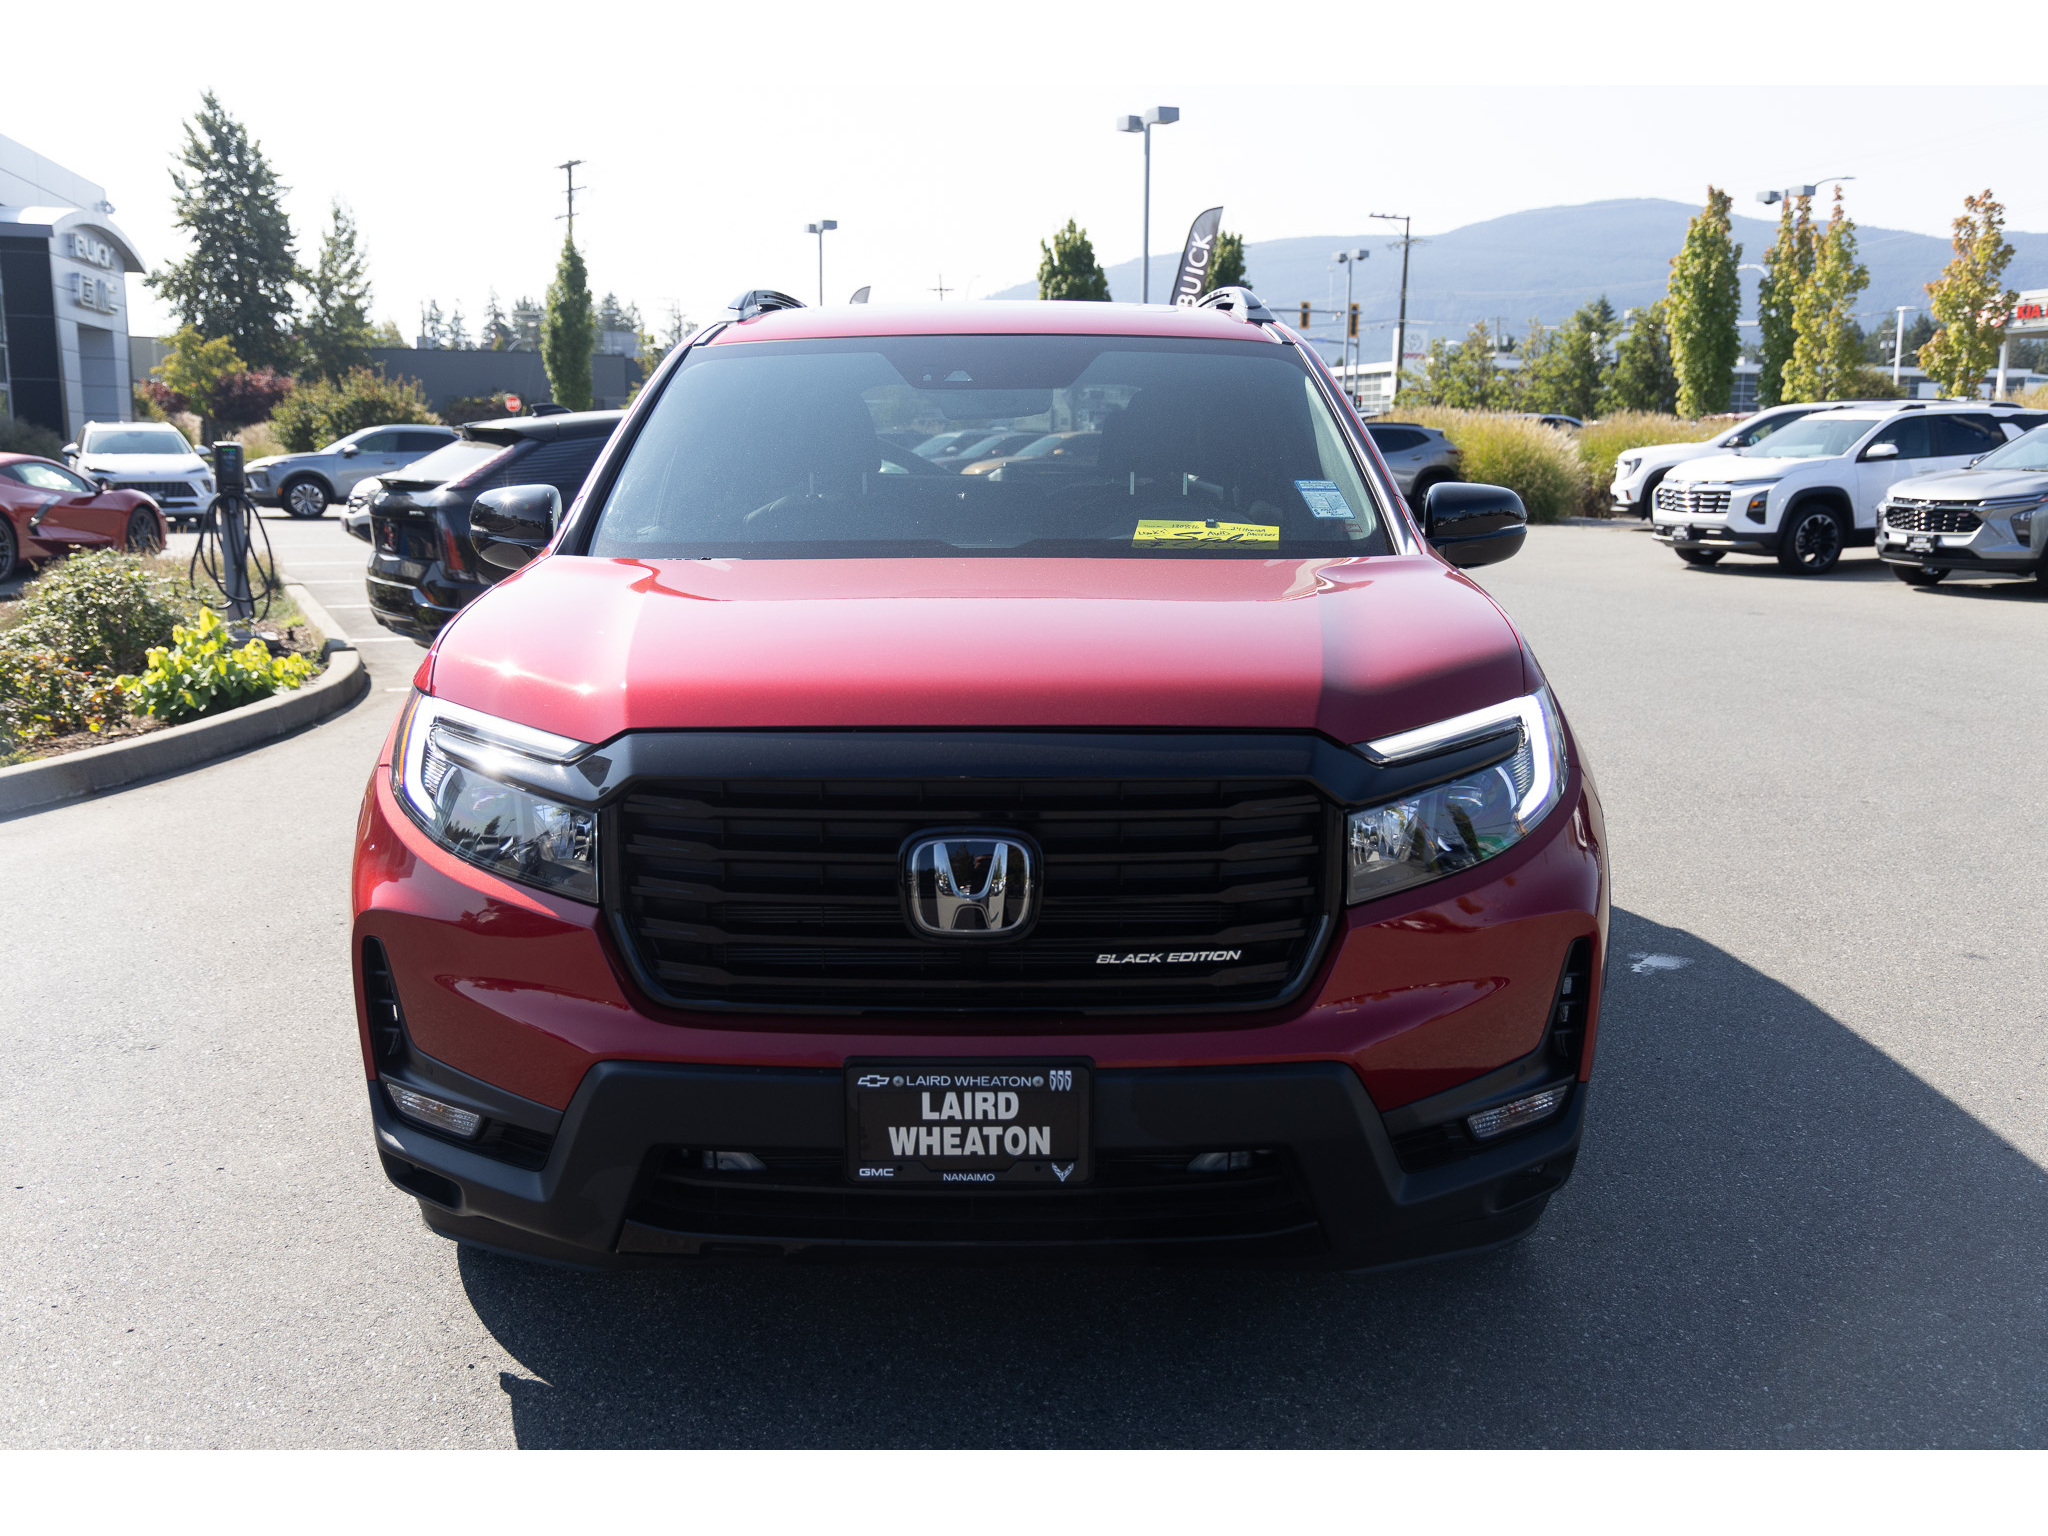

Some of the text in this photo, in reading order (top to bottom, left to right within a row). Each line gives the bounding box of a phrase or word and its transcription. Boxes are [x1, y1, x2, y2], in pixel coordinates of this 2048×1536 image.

[1176, 231, 1213, 307] BUICK
[2016, 304, 2041, 319] KIA
[1096, 950, 1242, 964] BLACK EDITION
[906, 1075, 1032, 1087] LAIRD WHEATON
[921, 1091, 1020, 1120] LAIRD
[888, 1125, 1051, 1156] WHEATON
[858, 1168, 894, 1177] GMC
[943, 1173, 996, 1182] NANAIMO
